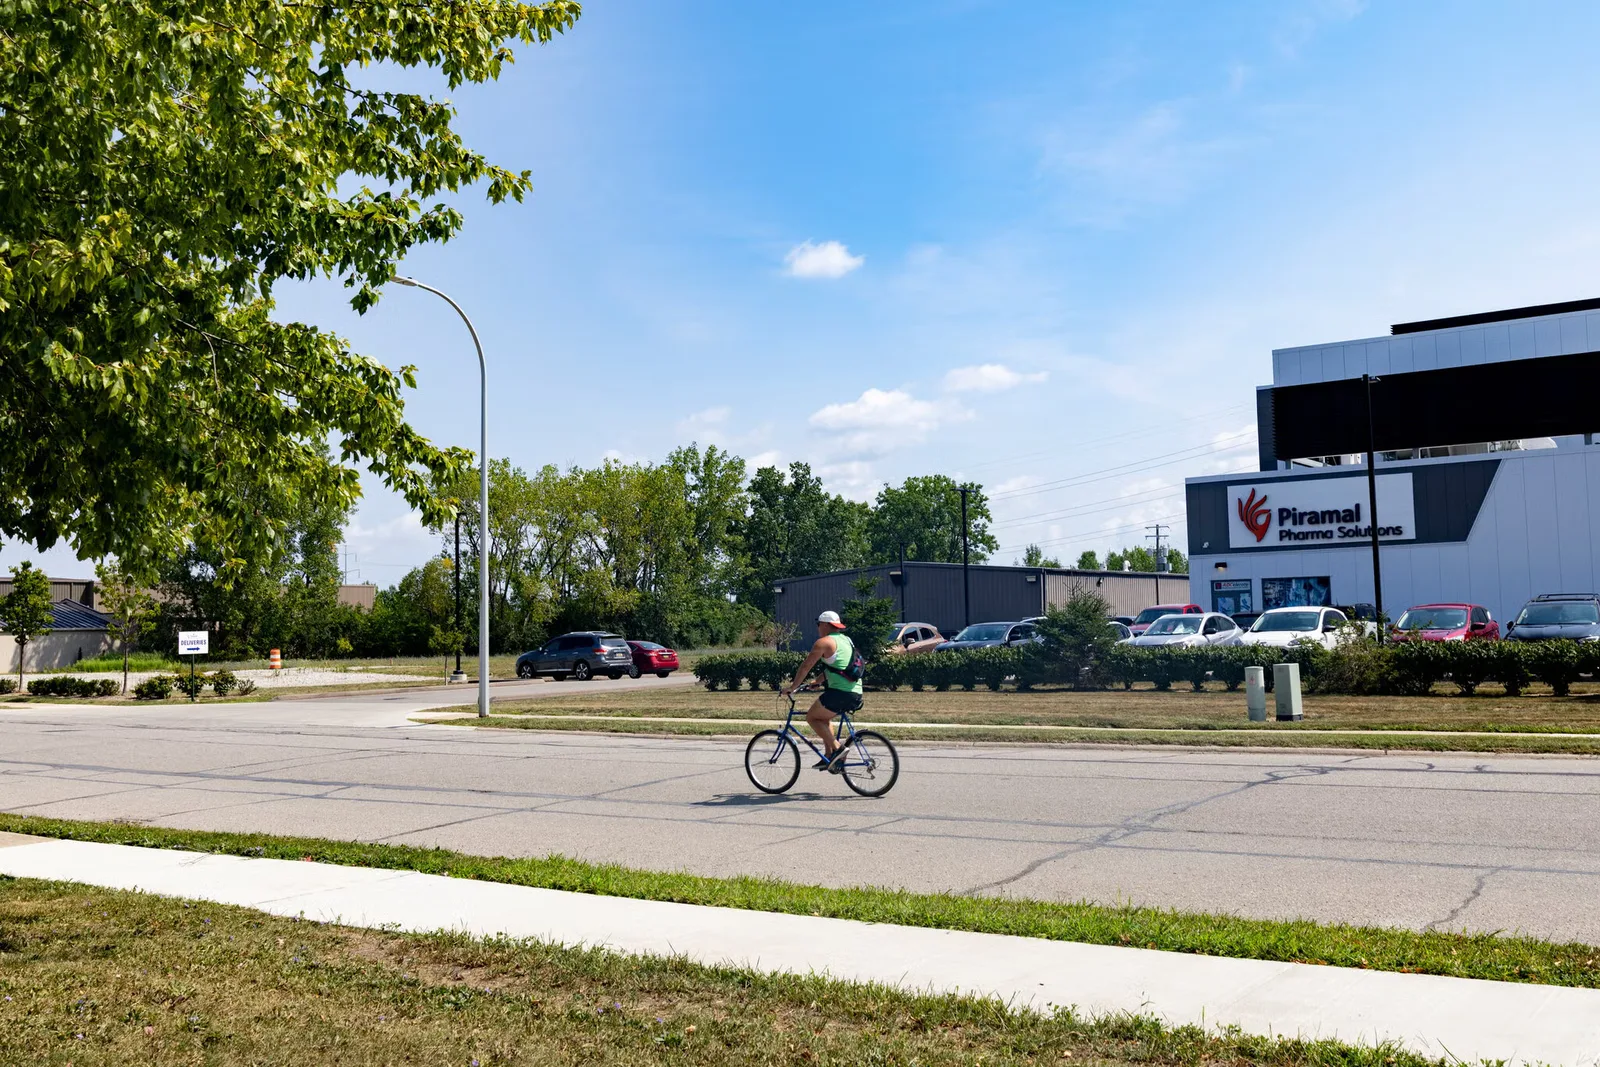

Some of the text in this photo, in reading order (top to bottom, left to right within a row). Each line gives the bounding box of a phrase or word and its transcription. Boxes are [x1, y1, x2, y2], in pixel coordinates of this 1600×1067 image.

[1278, 503, 1361, 526] Piramal
[1279, 524, 1403, 541] Pharma Solutons
